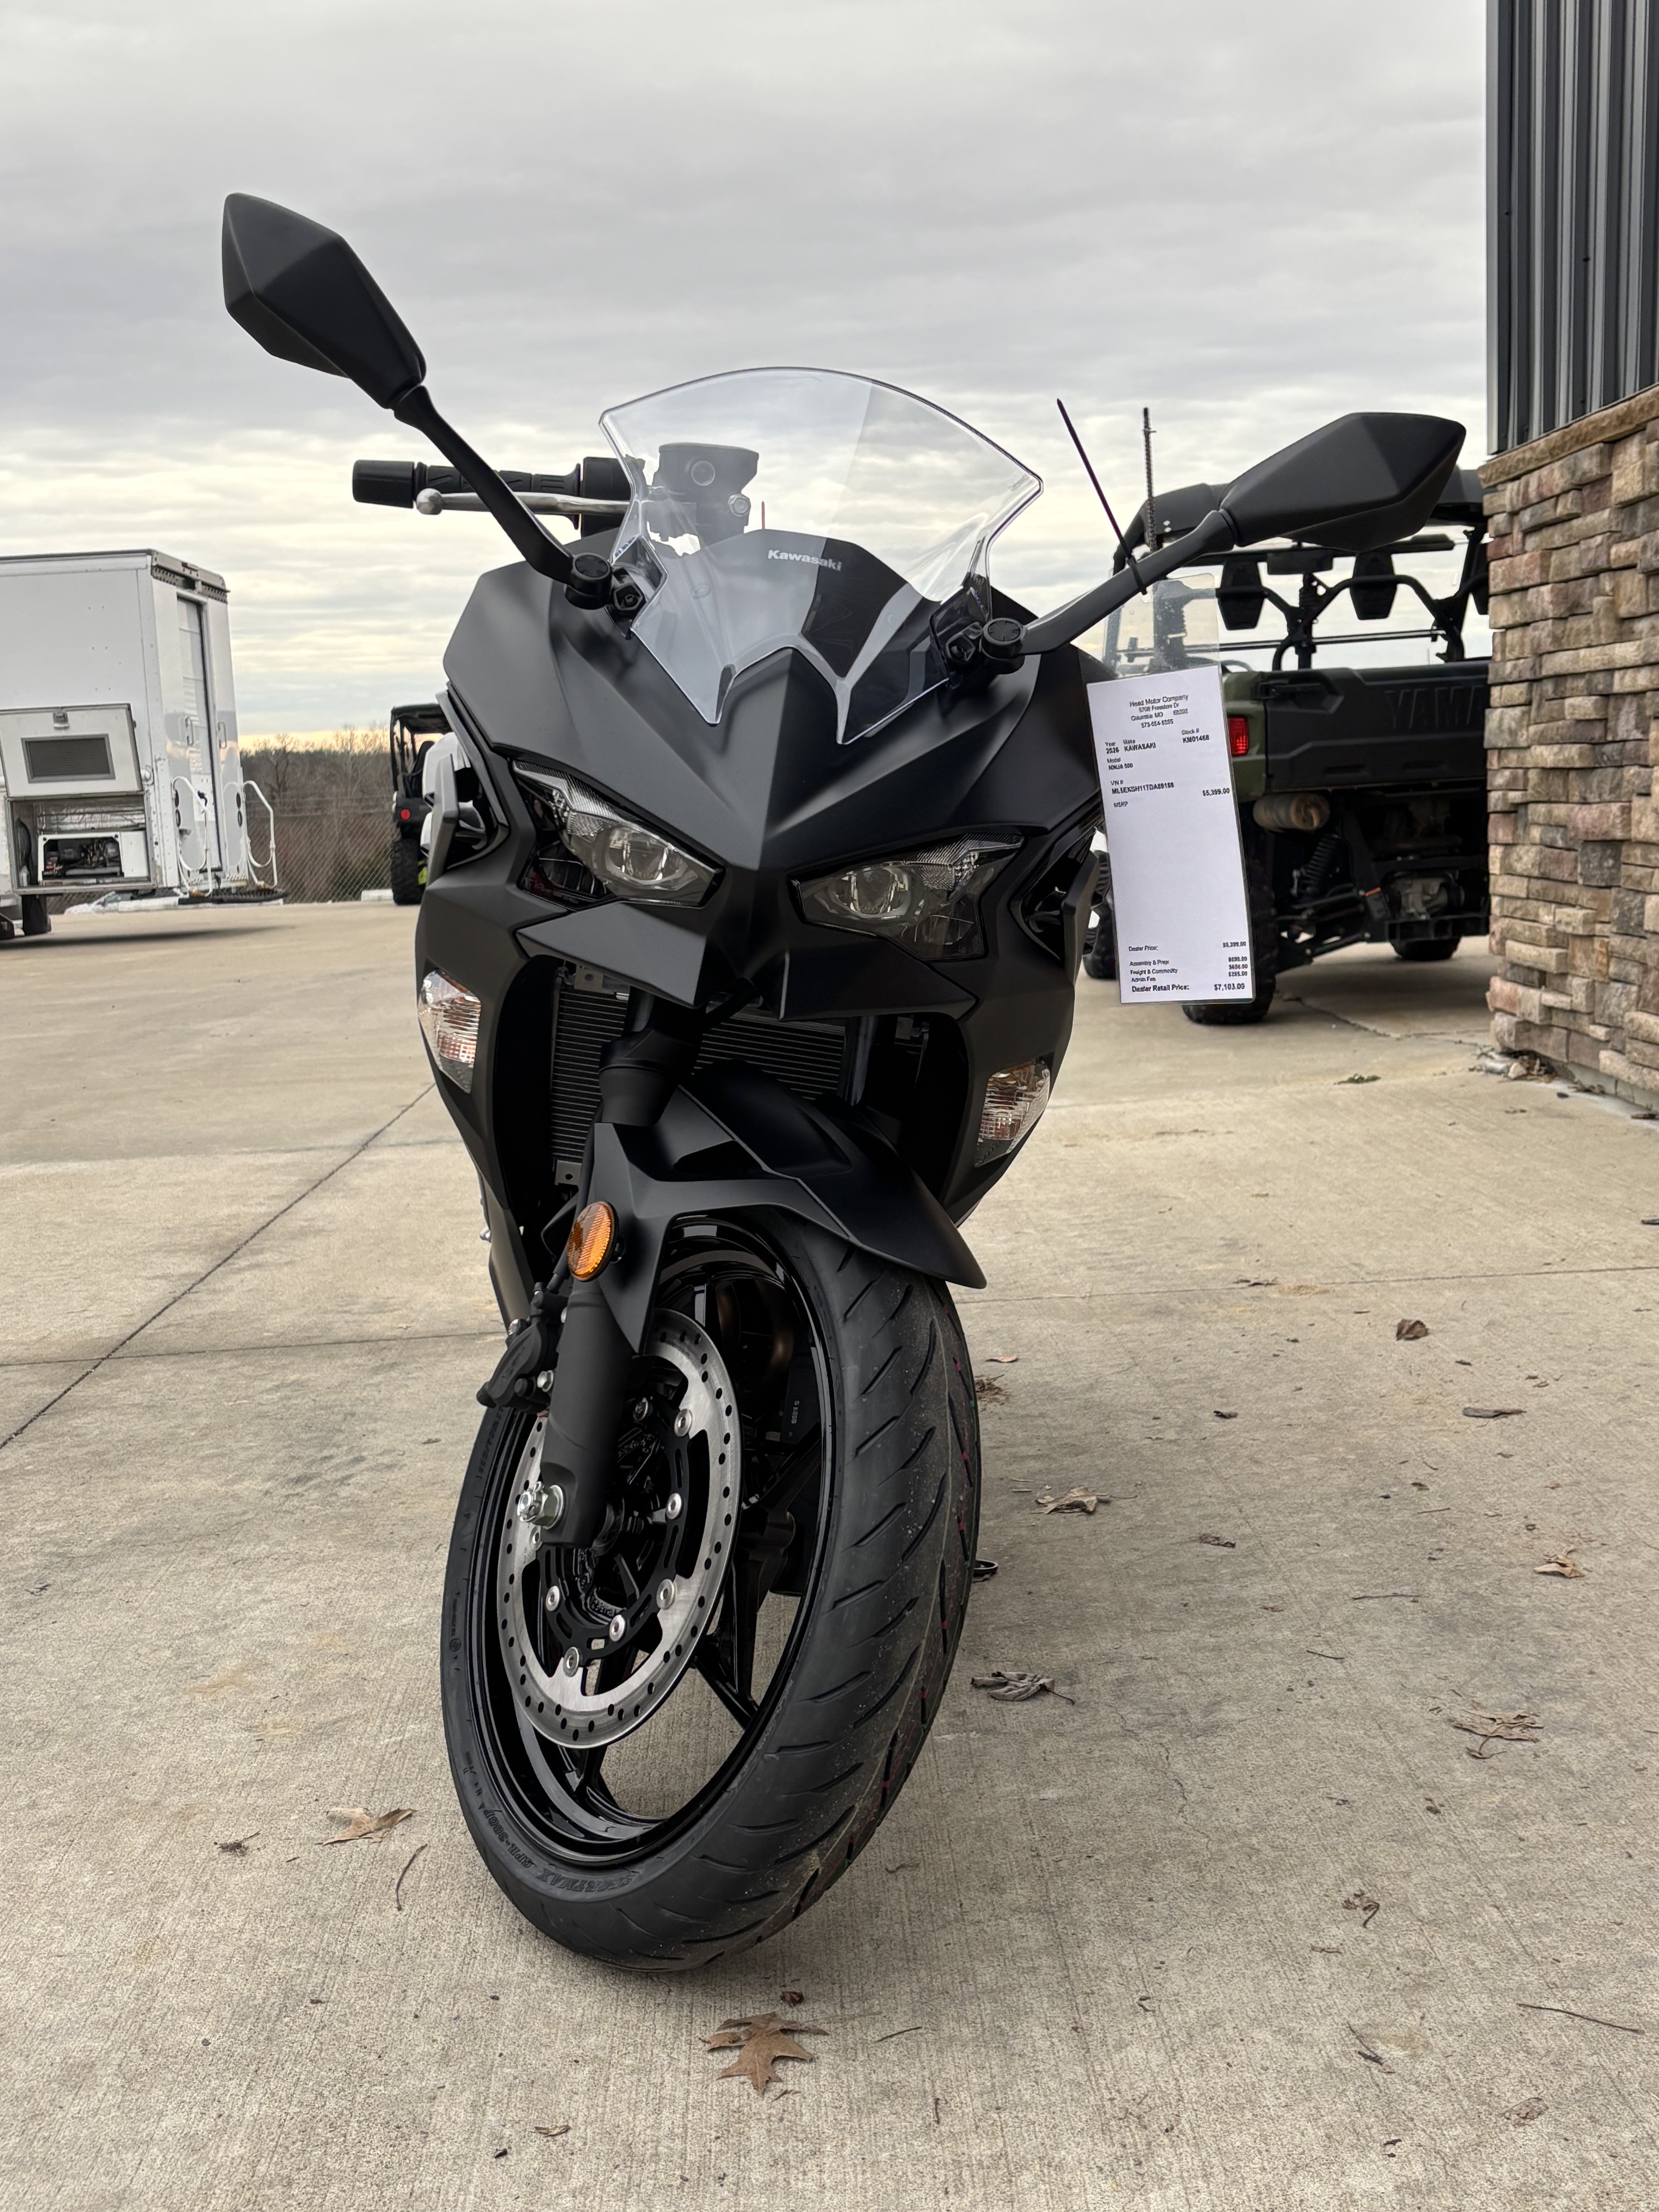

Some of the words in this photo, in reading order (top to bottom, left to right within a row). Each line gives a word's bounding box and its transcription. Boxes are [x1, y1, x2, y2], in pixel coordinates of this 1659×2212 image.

[768, 549, 842, 571] Kawasaki
[1182, 735, 1209, 743] KM01468
[1124, 742, 1156, 752] KAWASAKI
